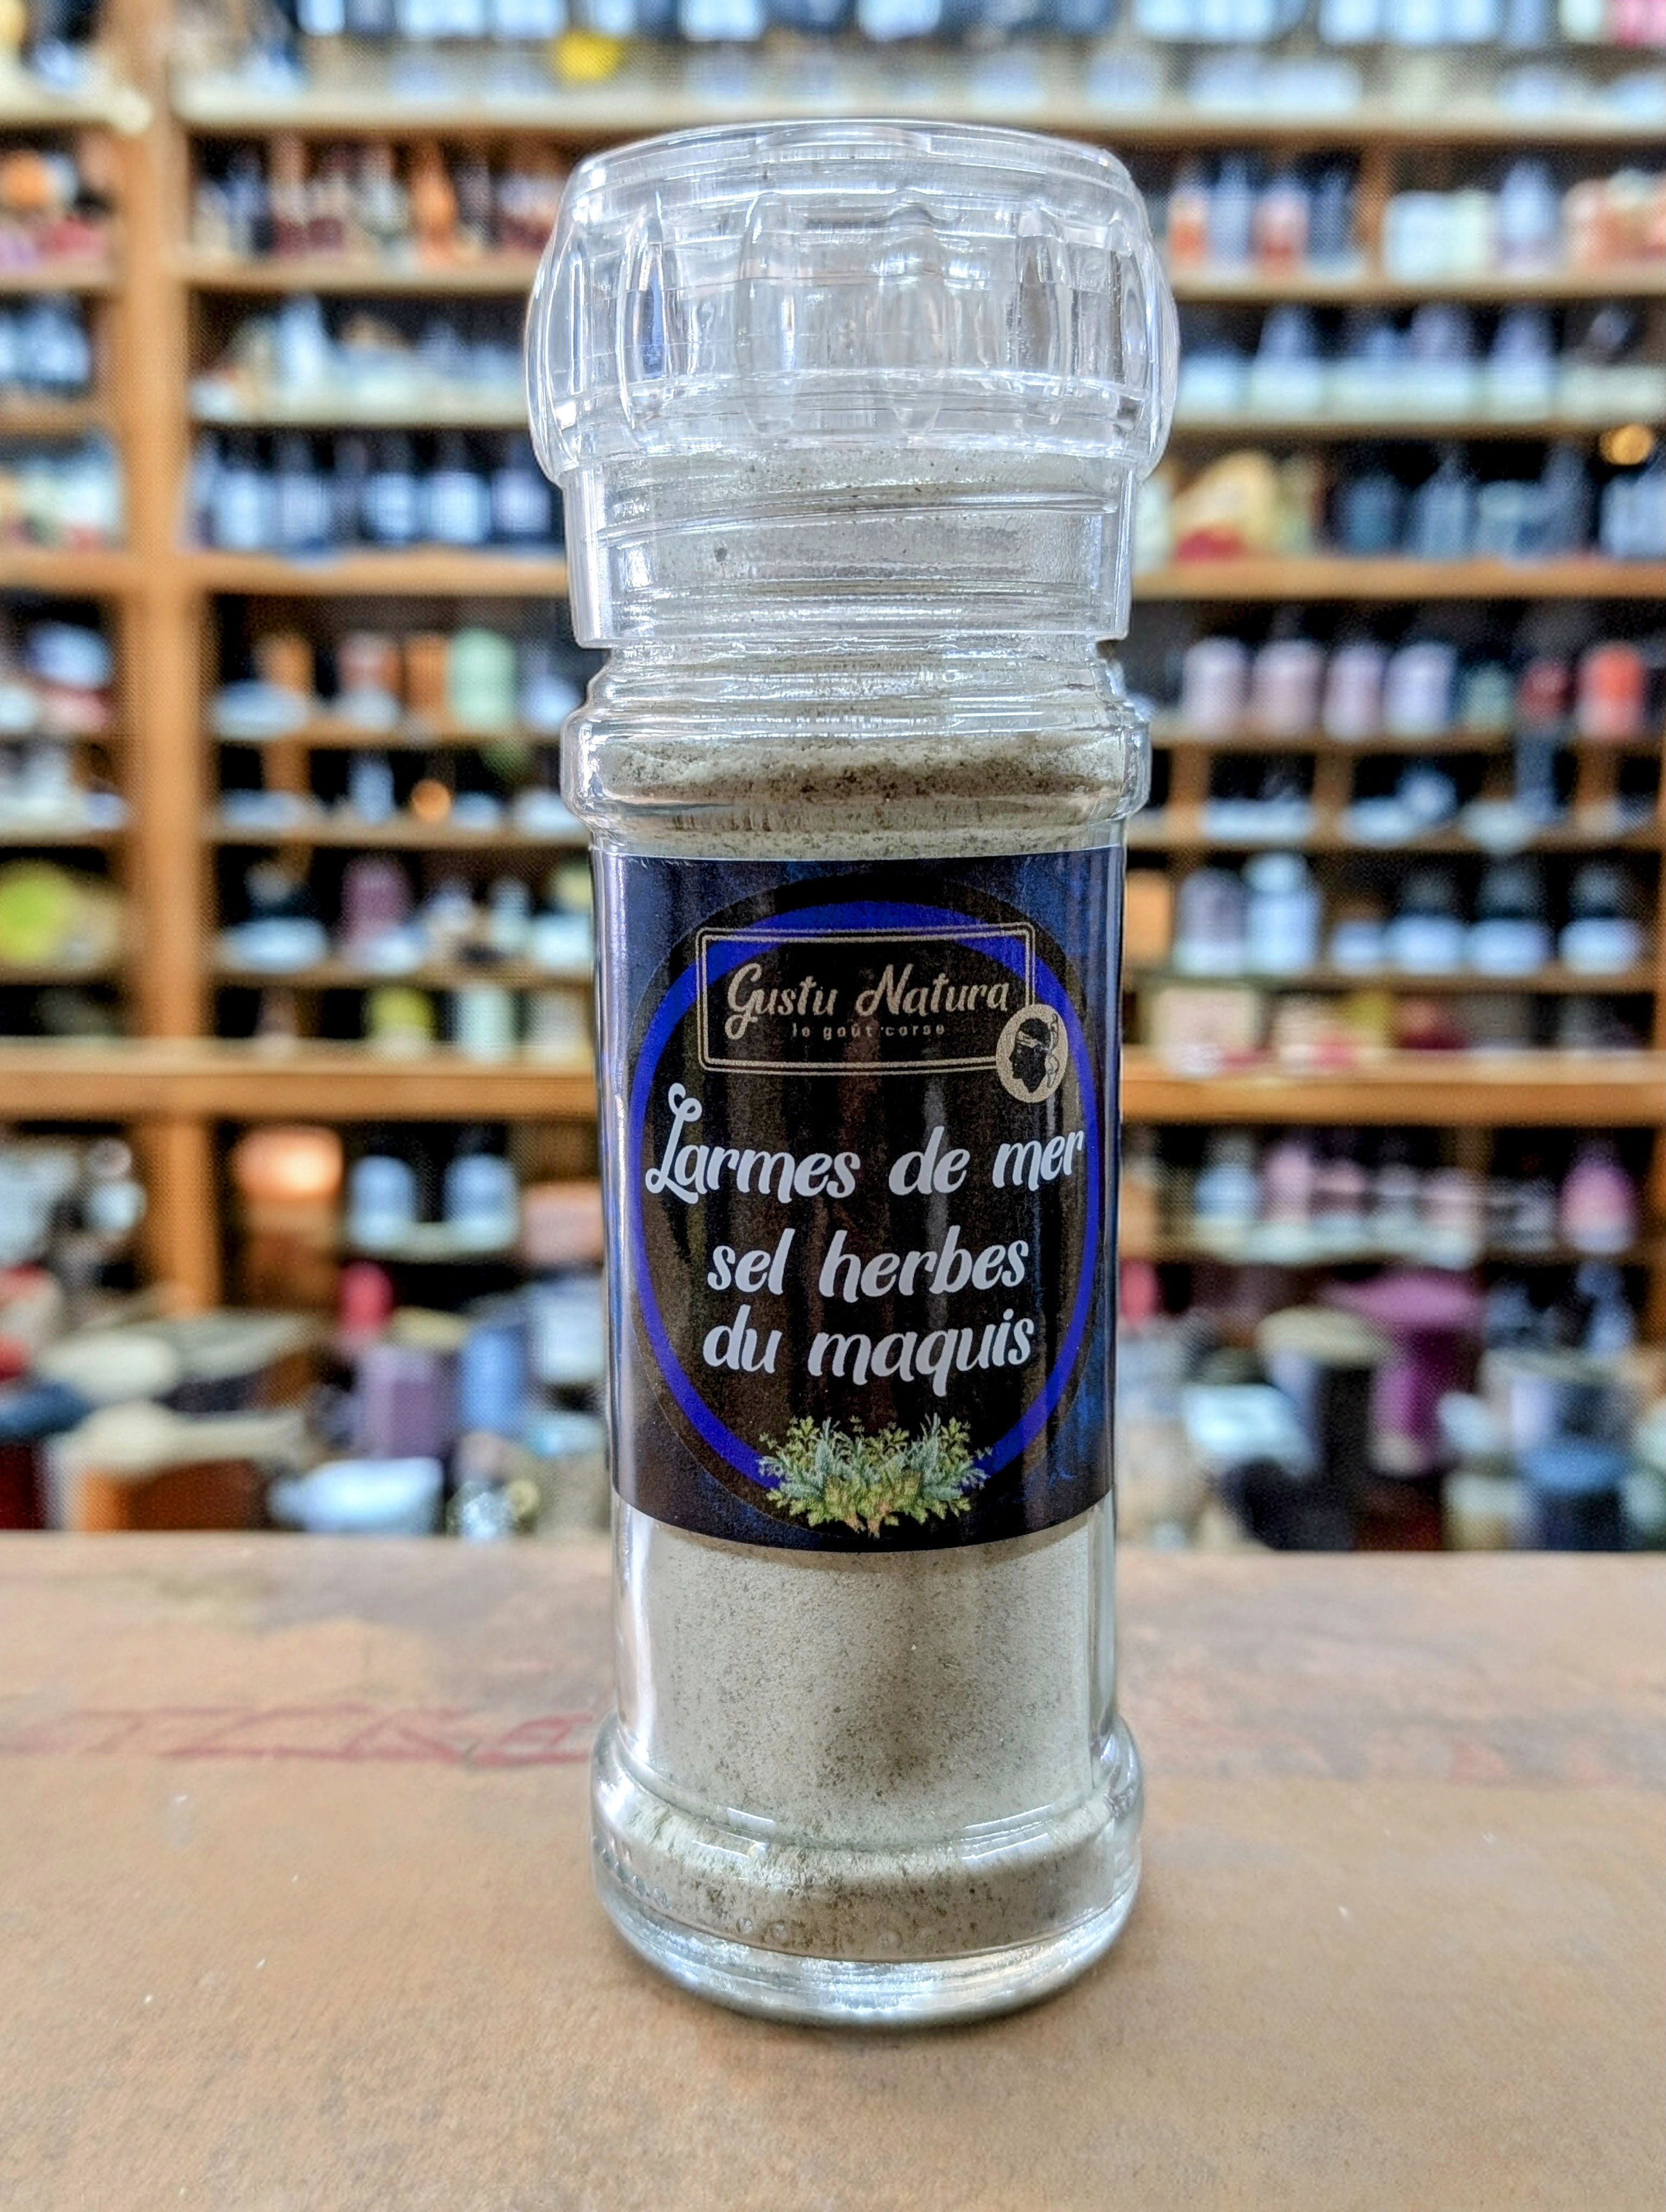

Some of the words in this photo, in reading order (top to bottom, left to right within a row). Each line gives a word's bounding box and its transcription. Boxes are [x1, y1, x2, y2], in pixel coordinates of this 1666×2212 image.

[725, 963, 838, 1040] Gustu
[856, 963, 1010, 1017] Natura
[792, 1023, 811, 1037] le
[885, 1024, 945, 1037] corse
[645, 1083, 861, 1204] Larmes
[888, 1126, 970, 1195] de
[992, 1130, 1085, 1191] mer
[707, 1228, 795, 1295] sel
[819, 1225, 1029, 1302] herbes
[702, 1304, 782, 1374] du
[808, 1309, 1034, 1397] maquis
